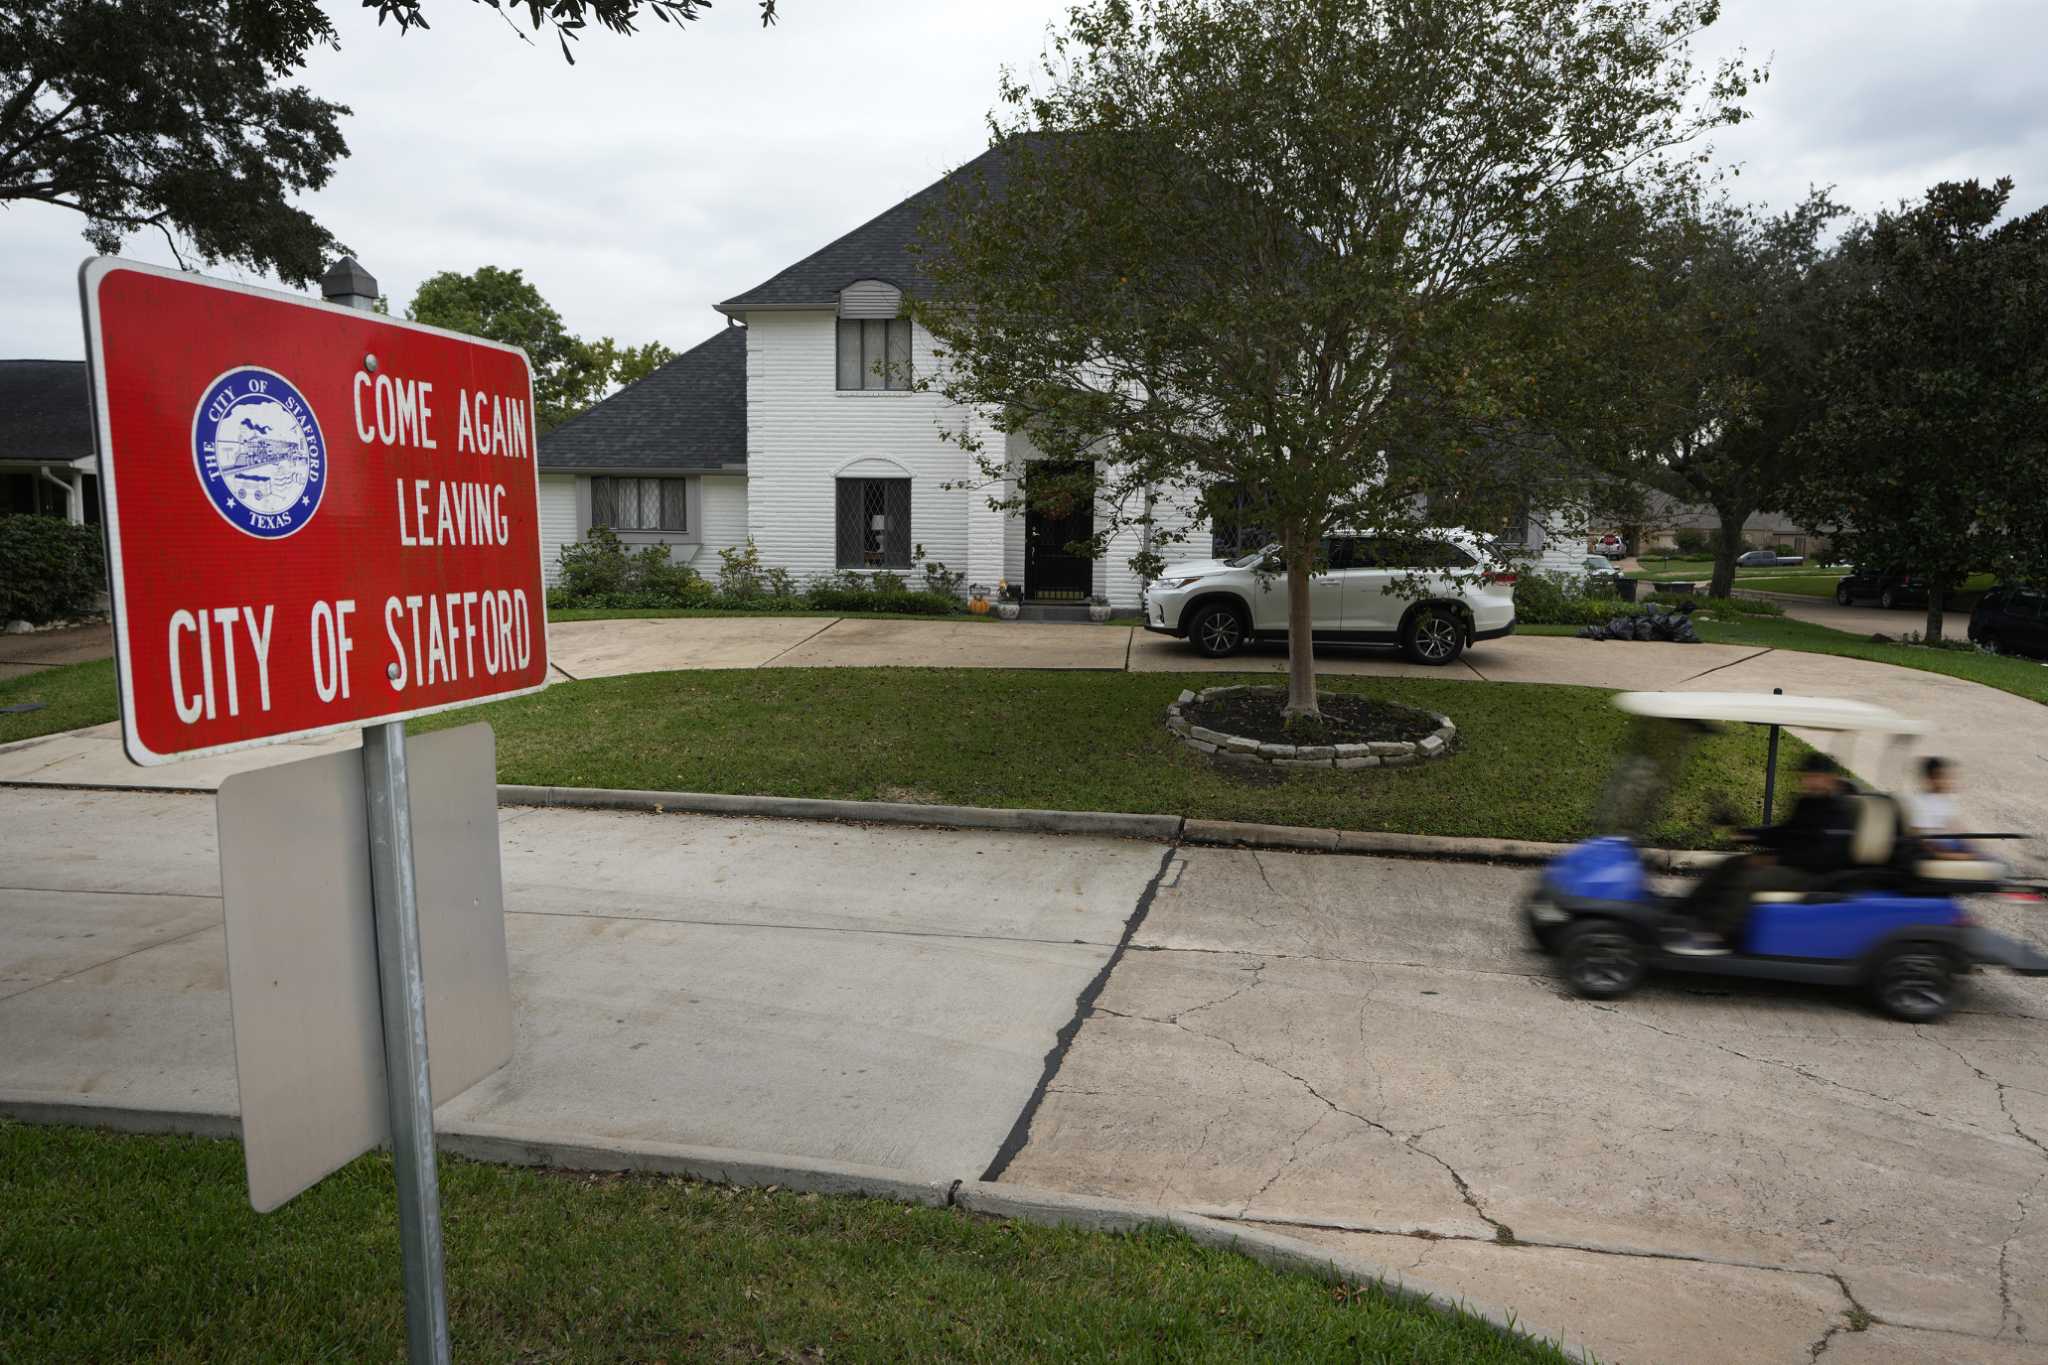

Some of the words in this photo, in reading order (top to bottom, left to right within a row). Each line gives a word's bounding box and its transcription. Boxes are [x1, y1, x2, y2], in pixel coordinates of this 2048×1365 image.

[208, 386, 236, 422] CITY
[249, 379, 268, 392] OF
[285, 397, 319, 482] STAFFORD
[354, 371, 437, 449] COME
[458, 389, 528, 459] AGAIN
[204, 441, 220, 481] THE
[249, 512, 292, 528] TEXAS
[396, 478, 509, 546] LEAVING
[169, 605, 274, 724] CITY
[311, 600, 356, 703] OF
[385, 589, 531, 692] STAFFORD
